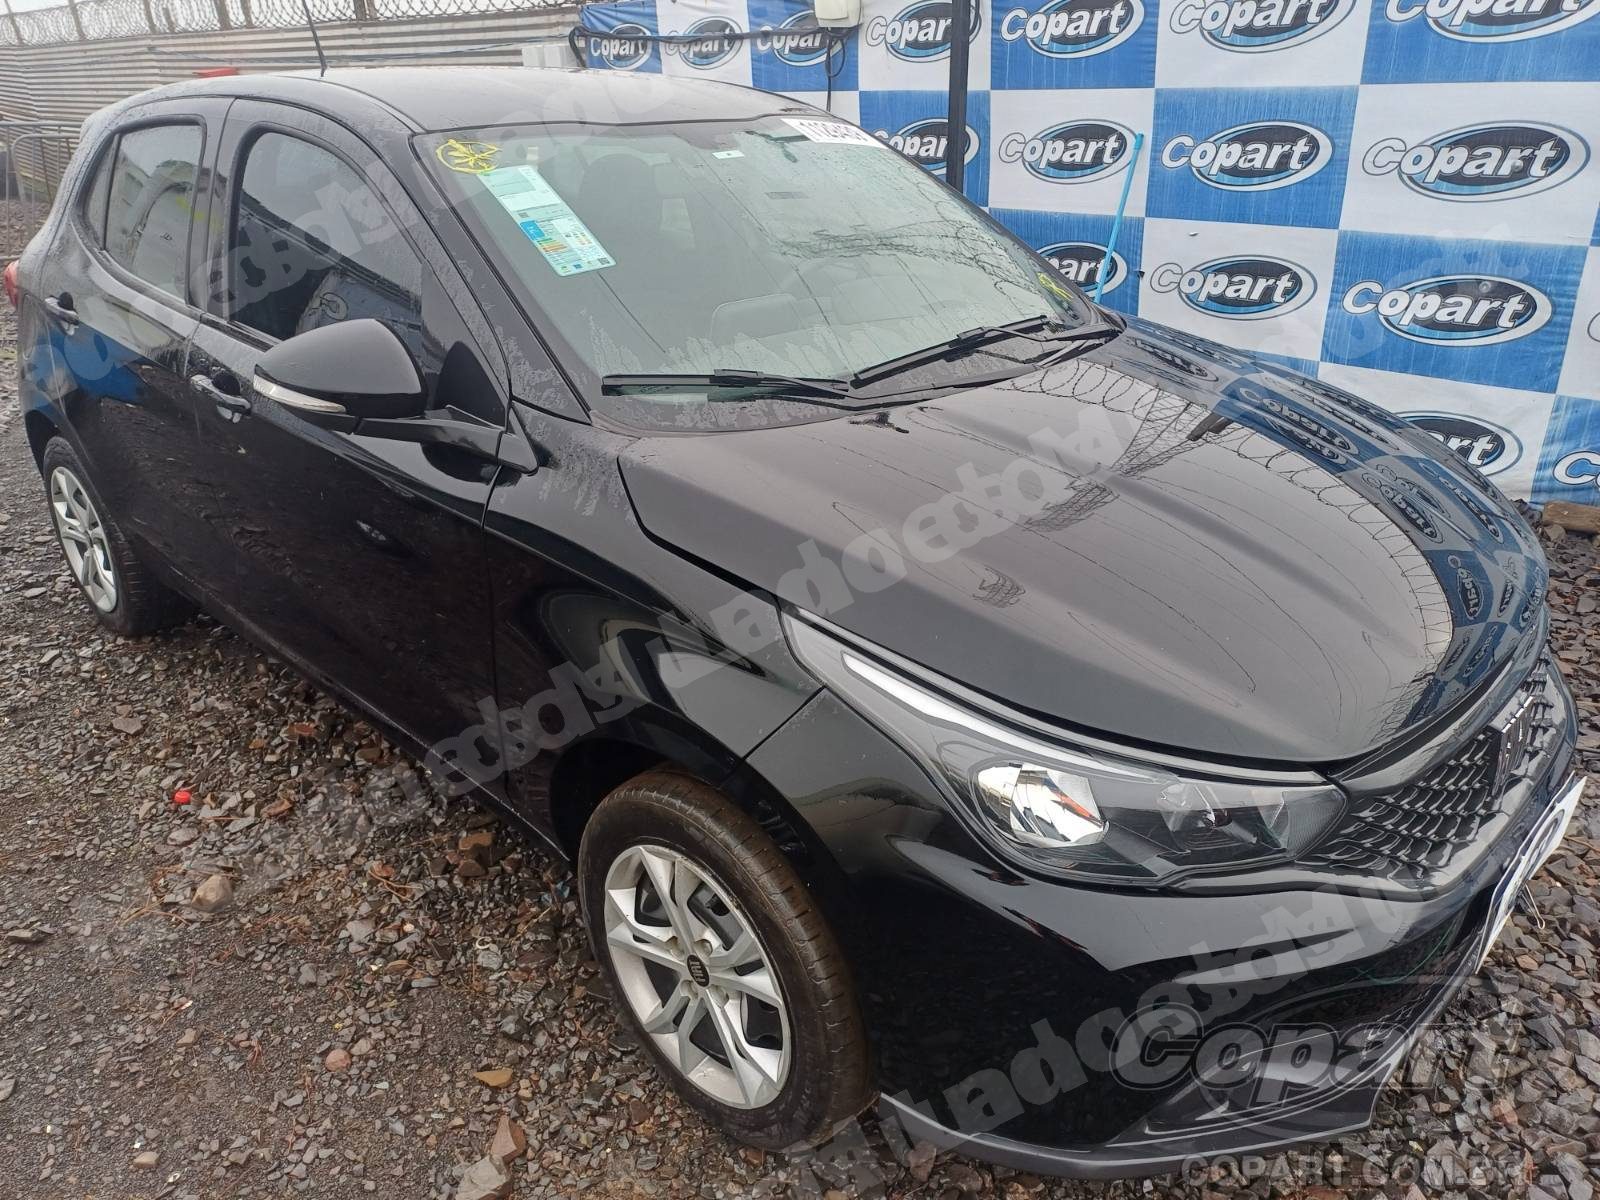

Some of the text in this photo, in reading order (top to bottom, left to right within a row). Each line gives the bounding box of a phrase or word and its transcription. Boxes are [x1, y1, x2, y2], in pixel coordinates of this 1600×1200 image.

[756, 25, 826, 55] Copar
[866, 15, 952, 48] Copar
[999, 1, 1125, 46] Copart
[590, 34, 645, 60] Copart
[874, 129, 949, 158] opar
[998, 131, 1122, 166] Copart
[1160, 134, 1316, 173] Copart
[1362, 136, 1565, 183] Copart
[1149, 262, 1295, 304] Copart
[1342, 280, 1526, 329] Copart
